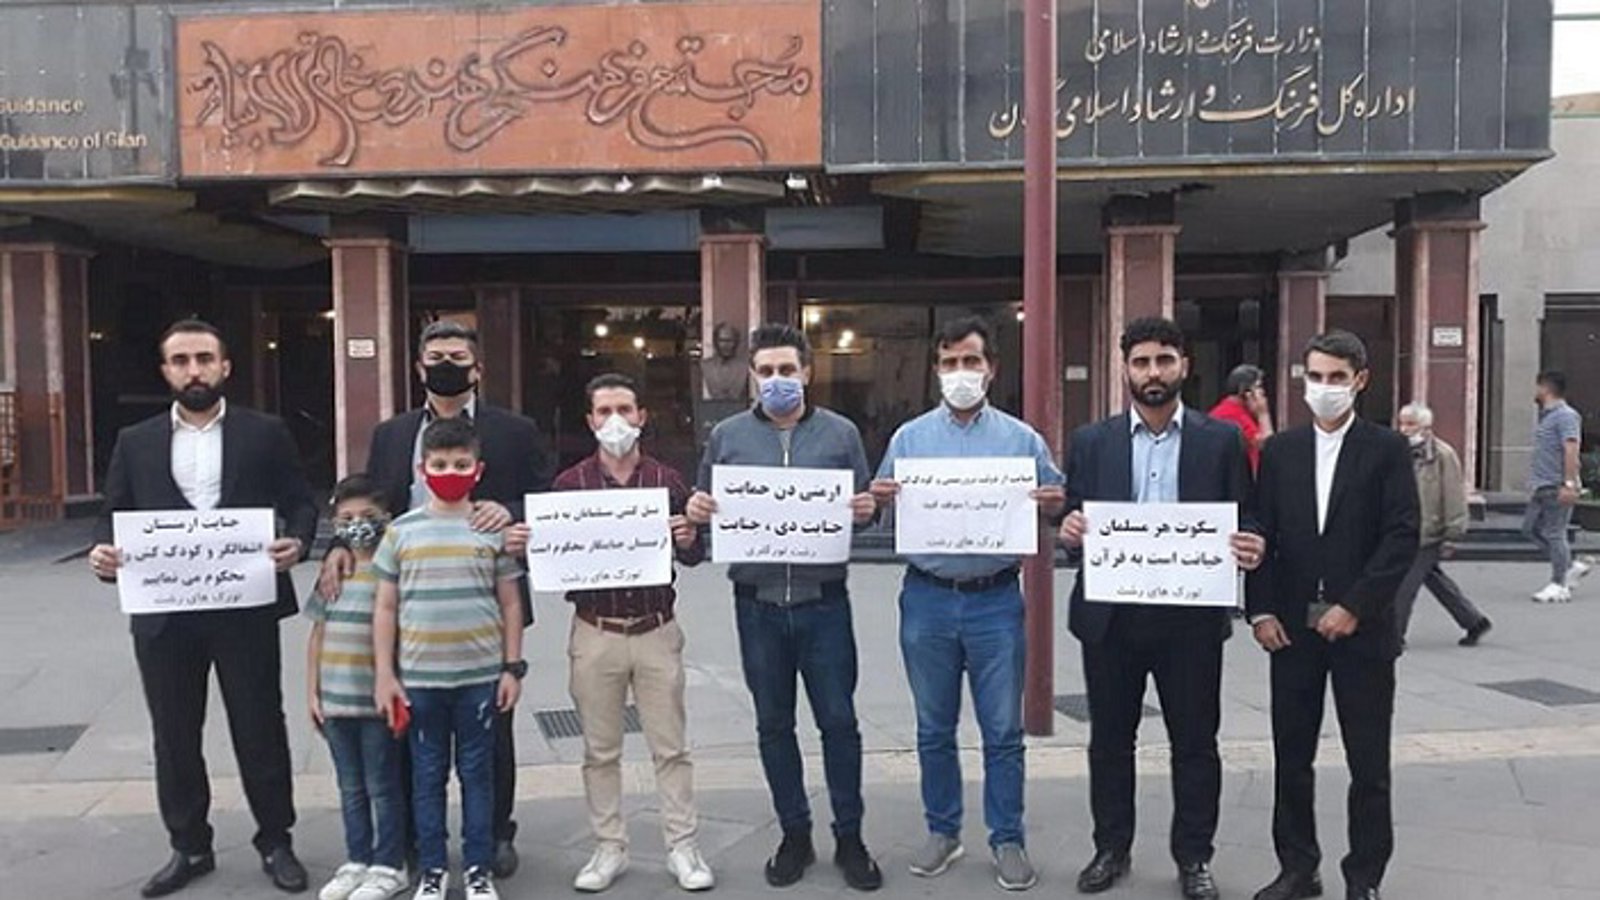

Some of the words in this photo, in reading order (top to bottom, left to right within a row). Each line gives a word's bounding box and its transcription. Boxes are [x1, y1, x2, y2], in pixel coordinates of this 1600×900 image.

[1085, 28, 1146, 62] اسلامی
[1147, 24, 1193, 55] ارشاد
[1195, 17, 1253, 65] فرهنگ
[1256, 26, 1321, 57] وزارت
[1128, 79, 1196, 124] ارشاد
[1199, 65, 1320, 132] فرهنگ
[1317, 72, 1366, 135] کل
[1353, 86, 1415, 117] اداره
[1056, 86, 1130, 140] اسلامی
[724, 480, 770, 499] حمایت
[774, 484, 796, 500] دن
[799, 484, 841, 502] ارمنی
[774, 521, 797, 537] دی
[1099, 518, 1149, 537] مسلمان
[1153, 522, 1171, 538] هر
[1174, 519, 1218, 538] سکوت
[1090, 546, 1126, 568] قرآن
[1130, 552, 1144, 568] به
[1146, 550, 1178, 566] است
[204, 569, 245, 586] محکوم
